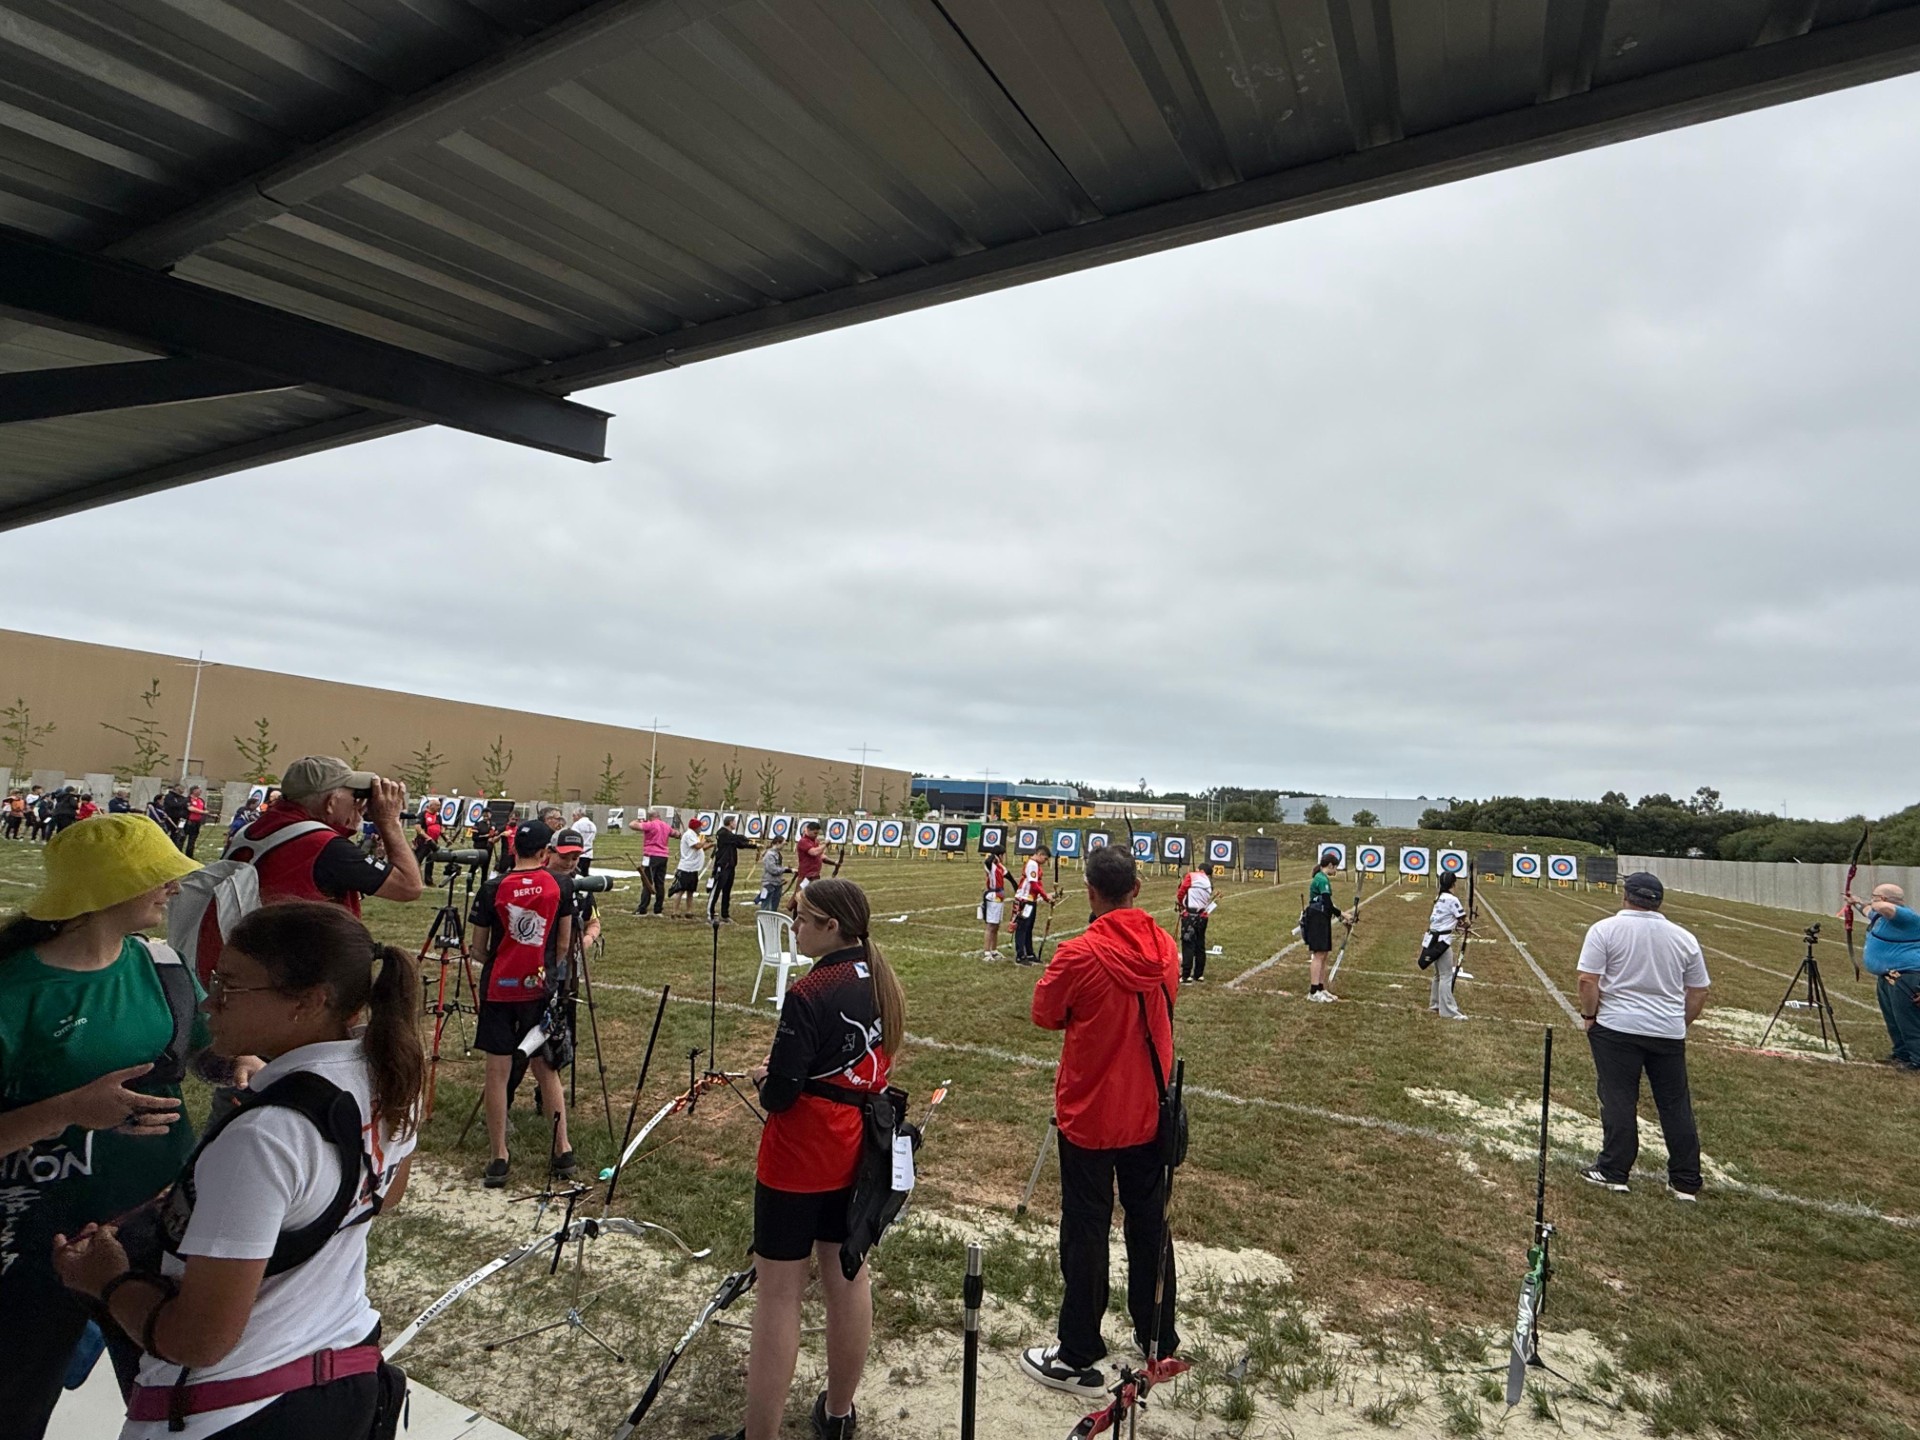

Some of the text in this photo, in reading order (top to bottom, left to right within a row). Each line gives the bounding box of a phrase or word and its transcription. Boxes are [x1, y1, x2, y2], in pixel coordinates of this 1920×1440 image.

[1214, 865, 1224, 875] 23
[1253, 869, 1264, 878] 24
[1409, 874, 1420, 883] 27
[513, 886, 542, 897] BERTO
[415, 1288, 459, 1328] ARCHERY
